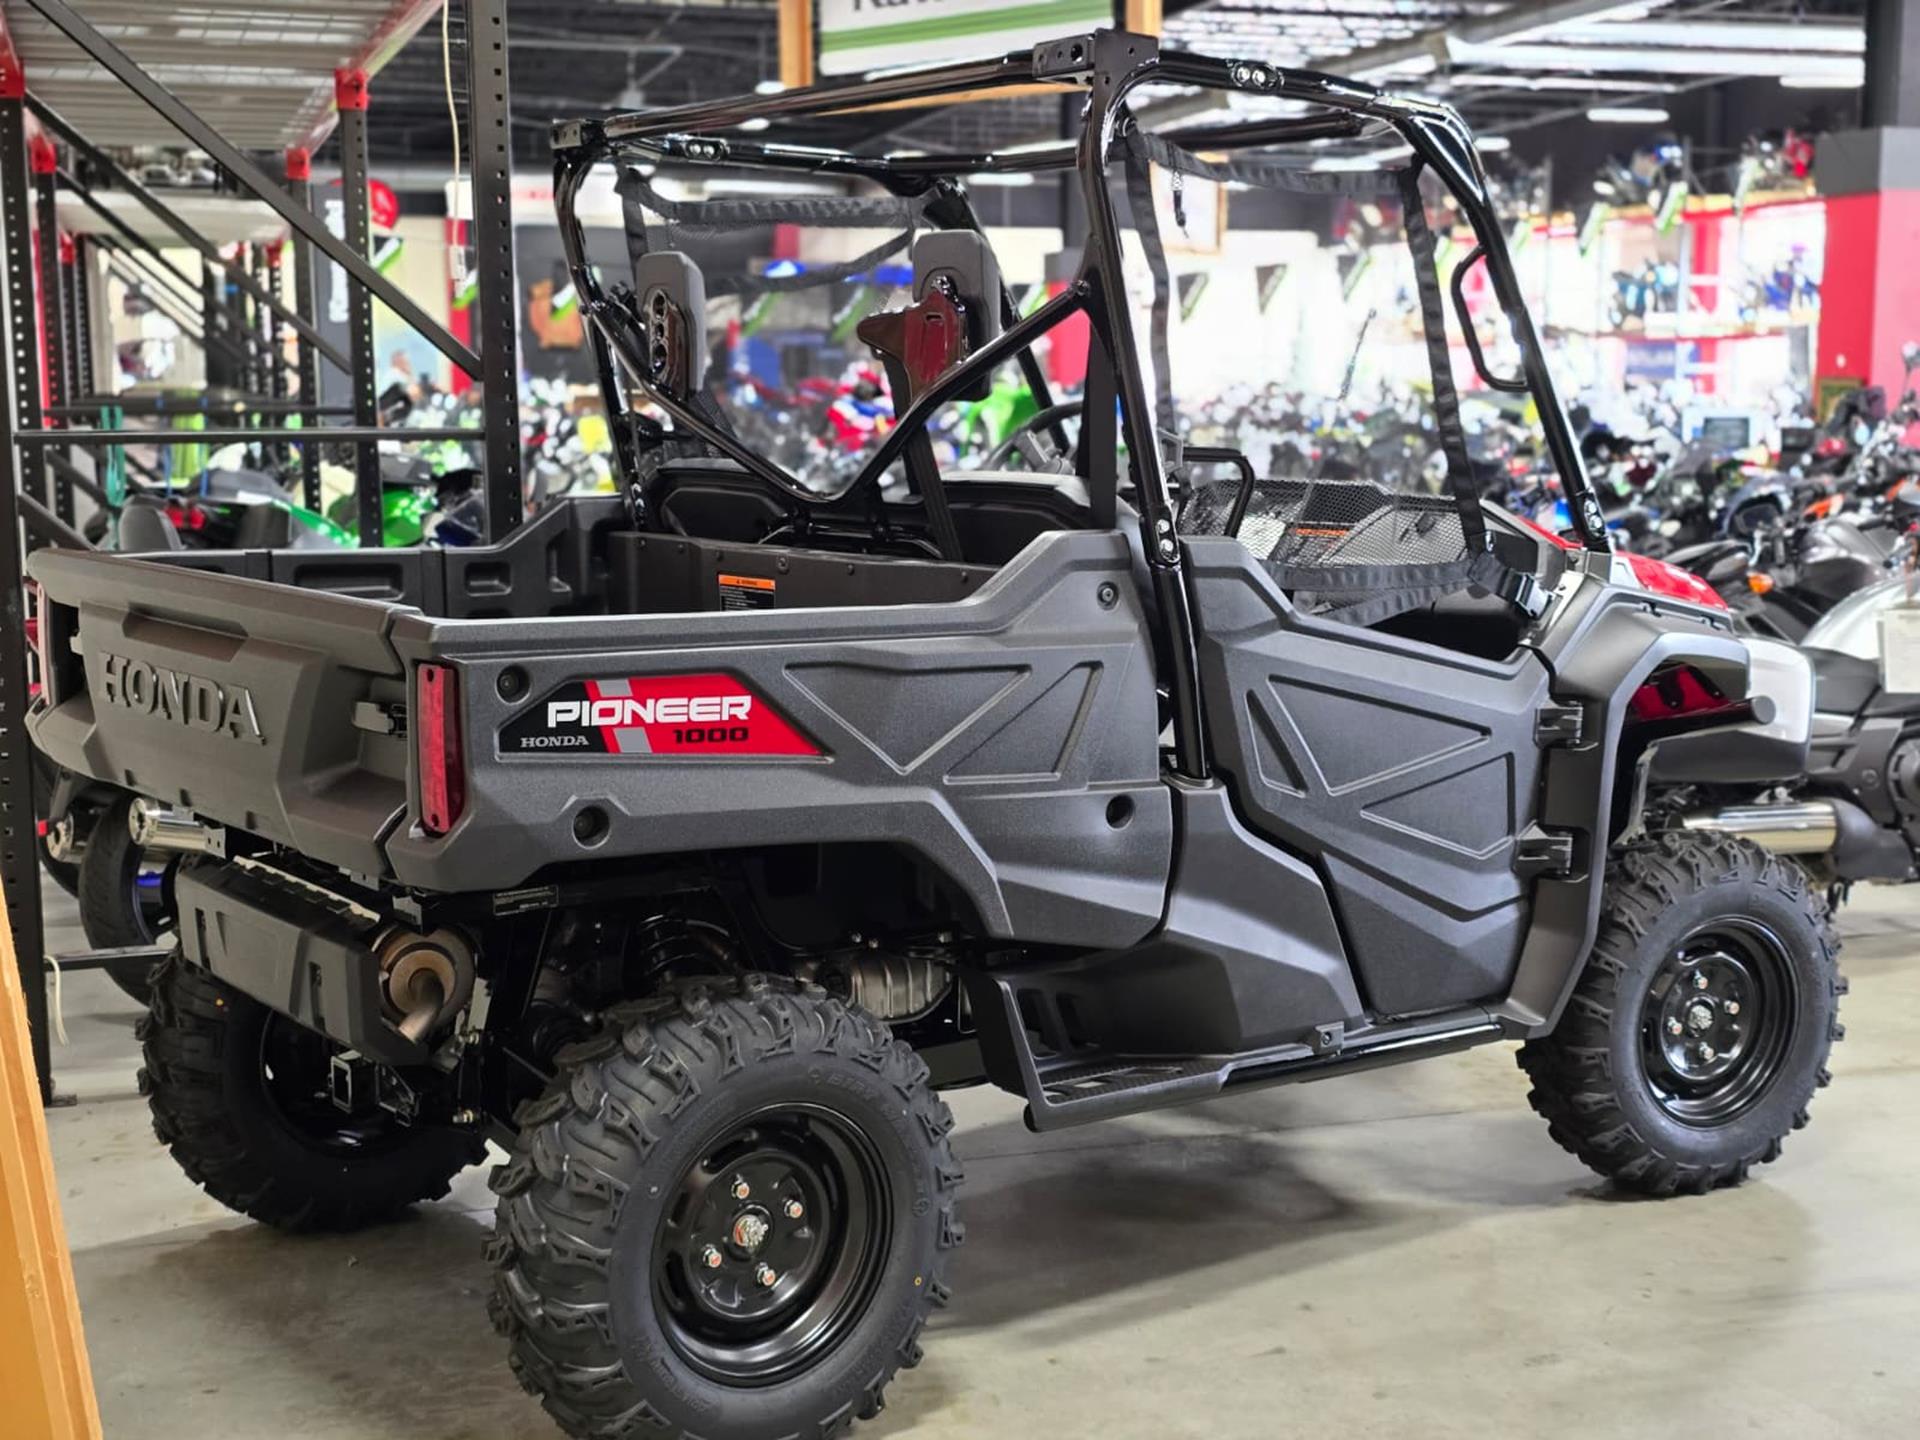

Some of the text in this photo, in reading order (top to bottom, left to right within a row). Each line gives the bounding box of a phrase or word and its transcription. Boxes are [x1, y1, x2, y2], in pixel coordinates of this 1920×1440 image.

[101, 652, 267, 745] HONDA
[547, 695, 752, 728] PIONEER
[520, 735, 589, 749] HONDA
[673, 727, 749, 745] 1000
